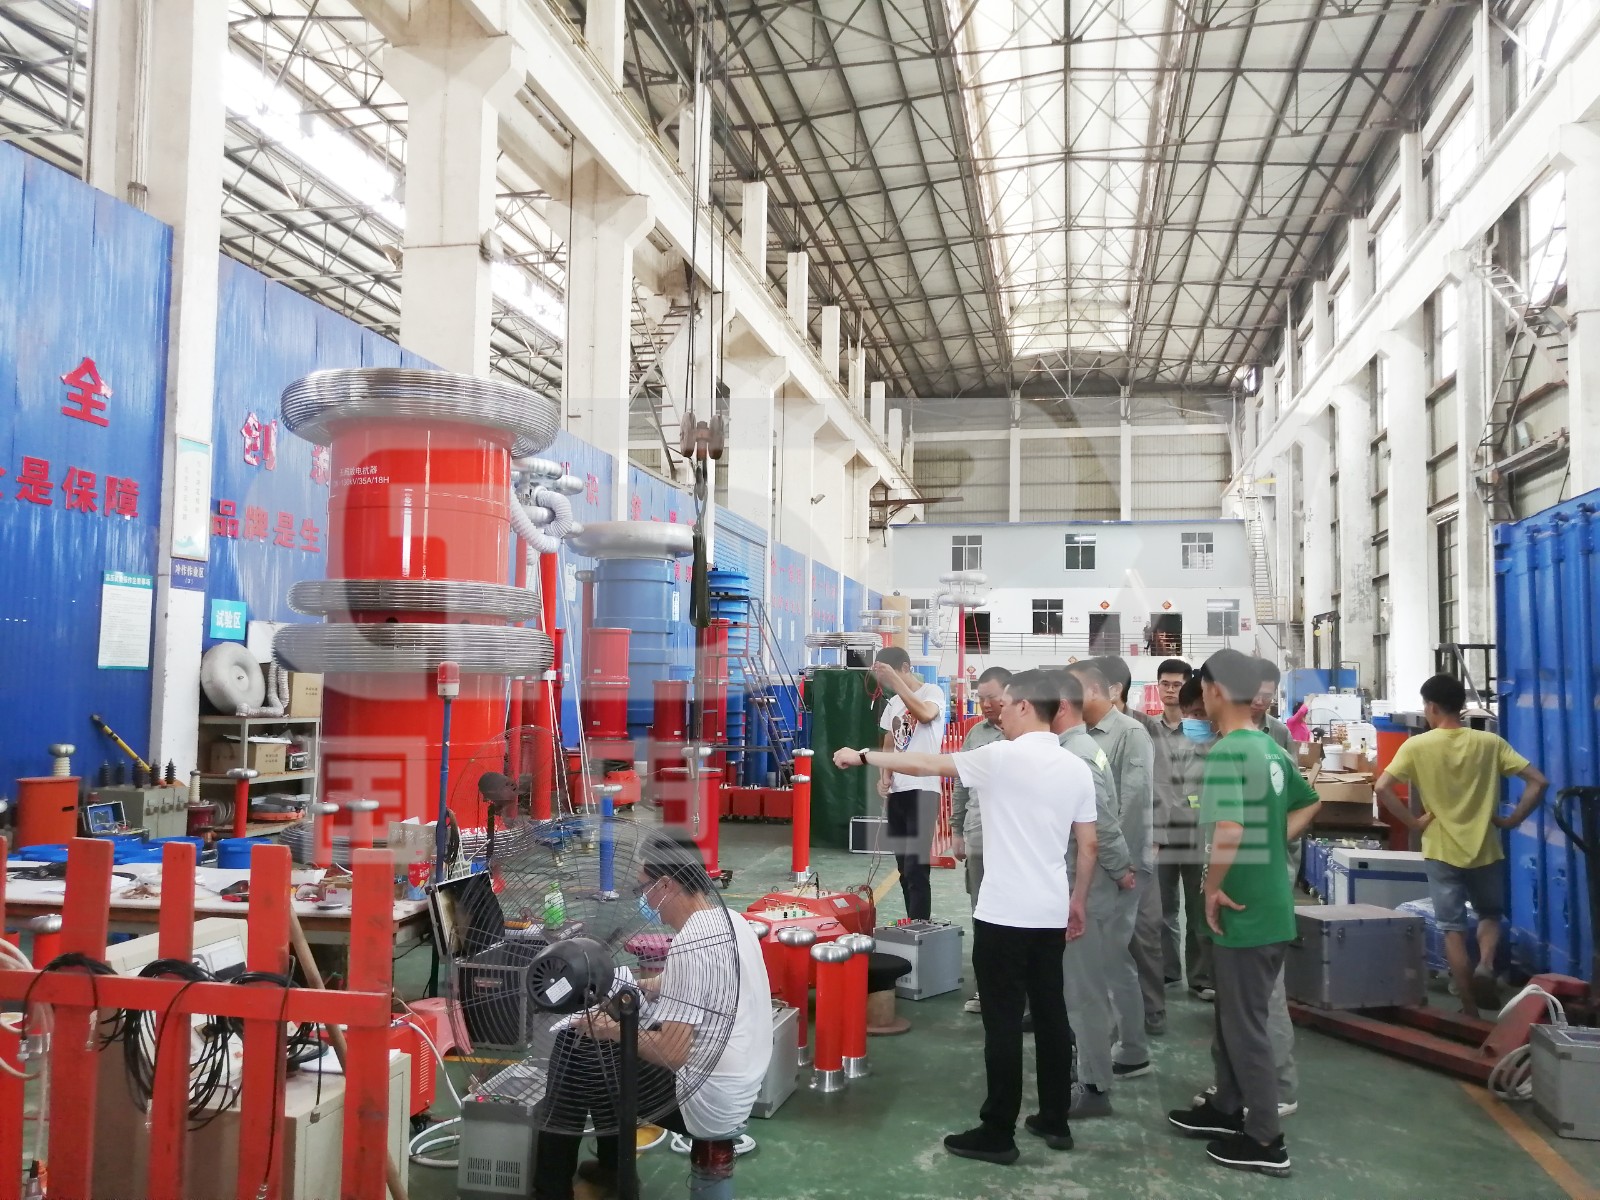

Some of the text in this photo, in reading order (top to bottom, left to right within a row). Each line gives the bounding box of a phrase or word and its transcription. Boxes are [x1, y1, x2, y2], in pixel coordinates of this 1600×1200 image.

[0, 455, 140, 518] 是保障
[212, 499, 321, 553] 品牌是生
[216, 610, 242, 628] 试验区
